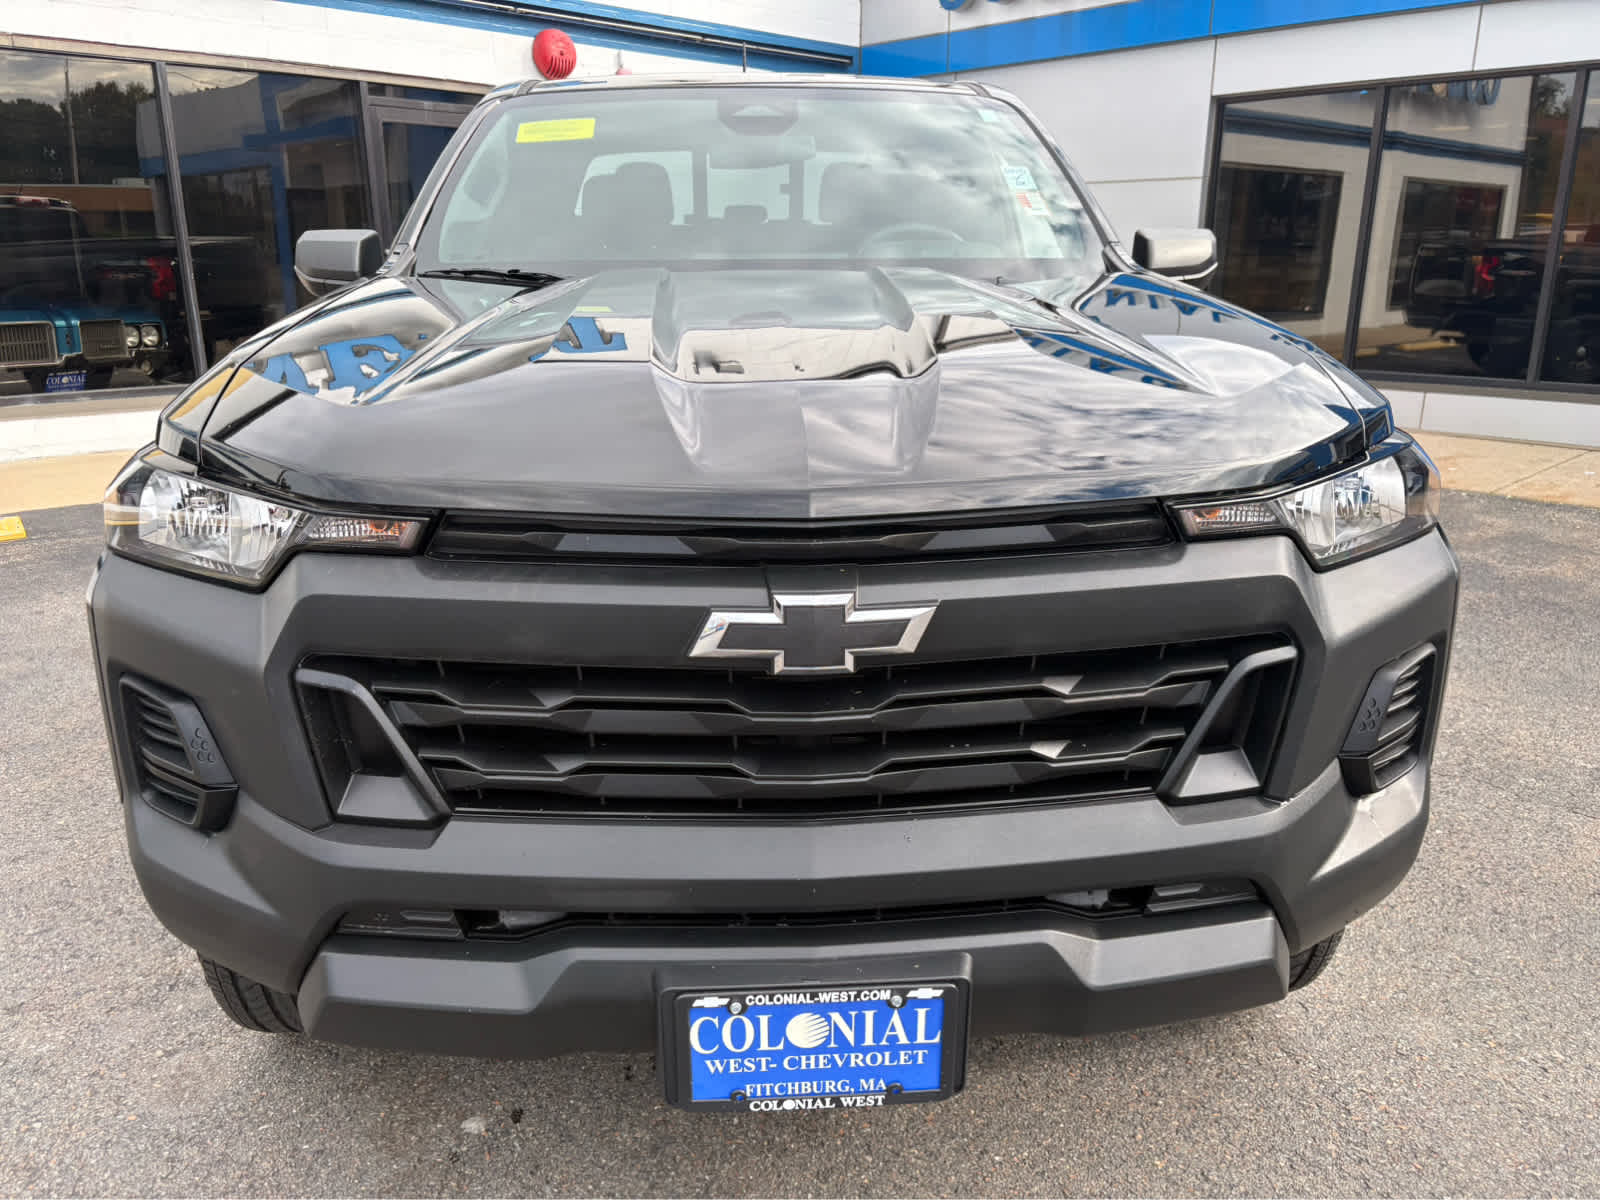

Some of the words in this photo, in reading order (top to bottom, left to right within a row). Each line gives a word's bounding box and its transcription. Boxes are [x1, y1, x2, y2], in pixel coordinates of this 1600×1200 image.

[745, 989, 891, 1006] COLONIAL-WEST.COM
[689, 1007, 942, 1054] COLONIAL
[783, 1049, 928, 1071] CHEVROLET
[745, 1079, 855, 1097] FITCHBURG,
[859, 1078, 887, 1091] MA
[749, 1097, 836, 1112] COLONIAL
[839, 1095, 886, 1107] WEST
